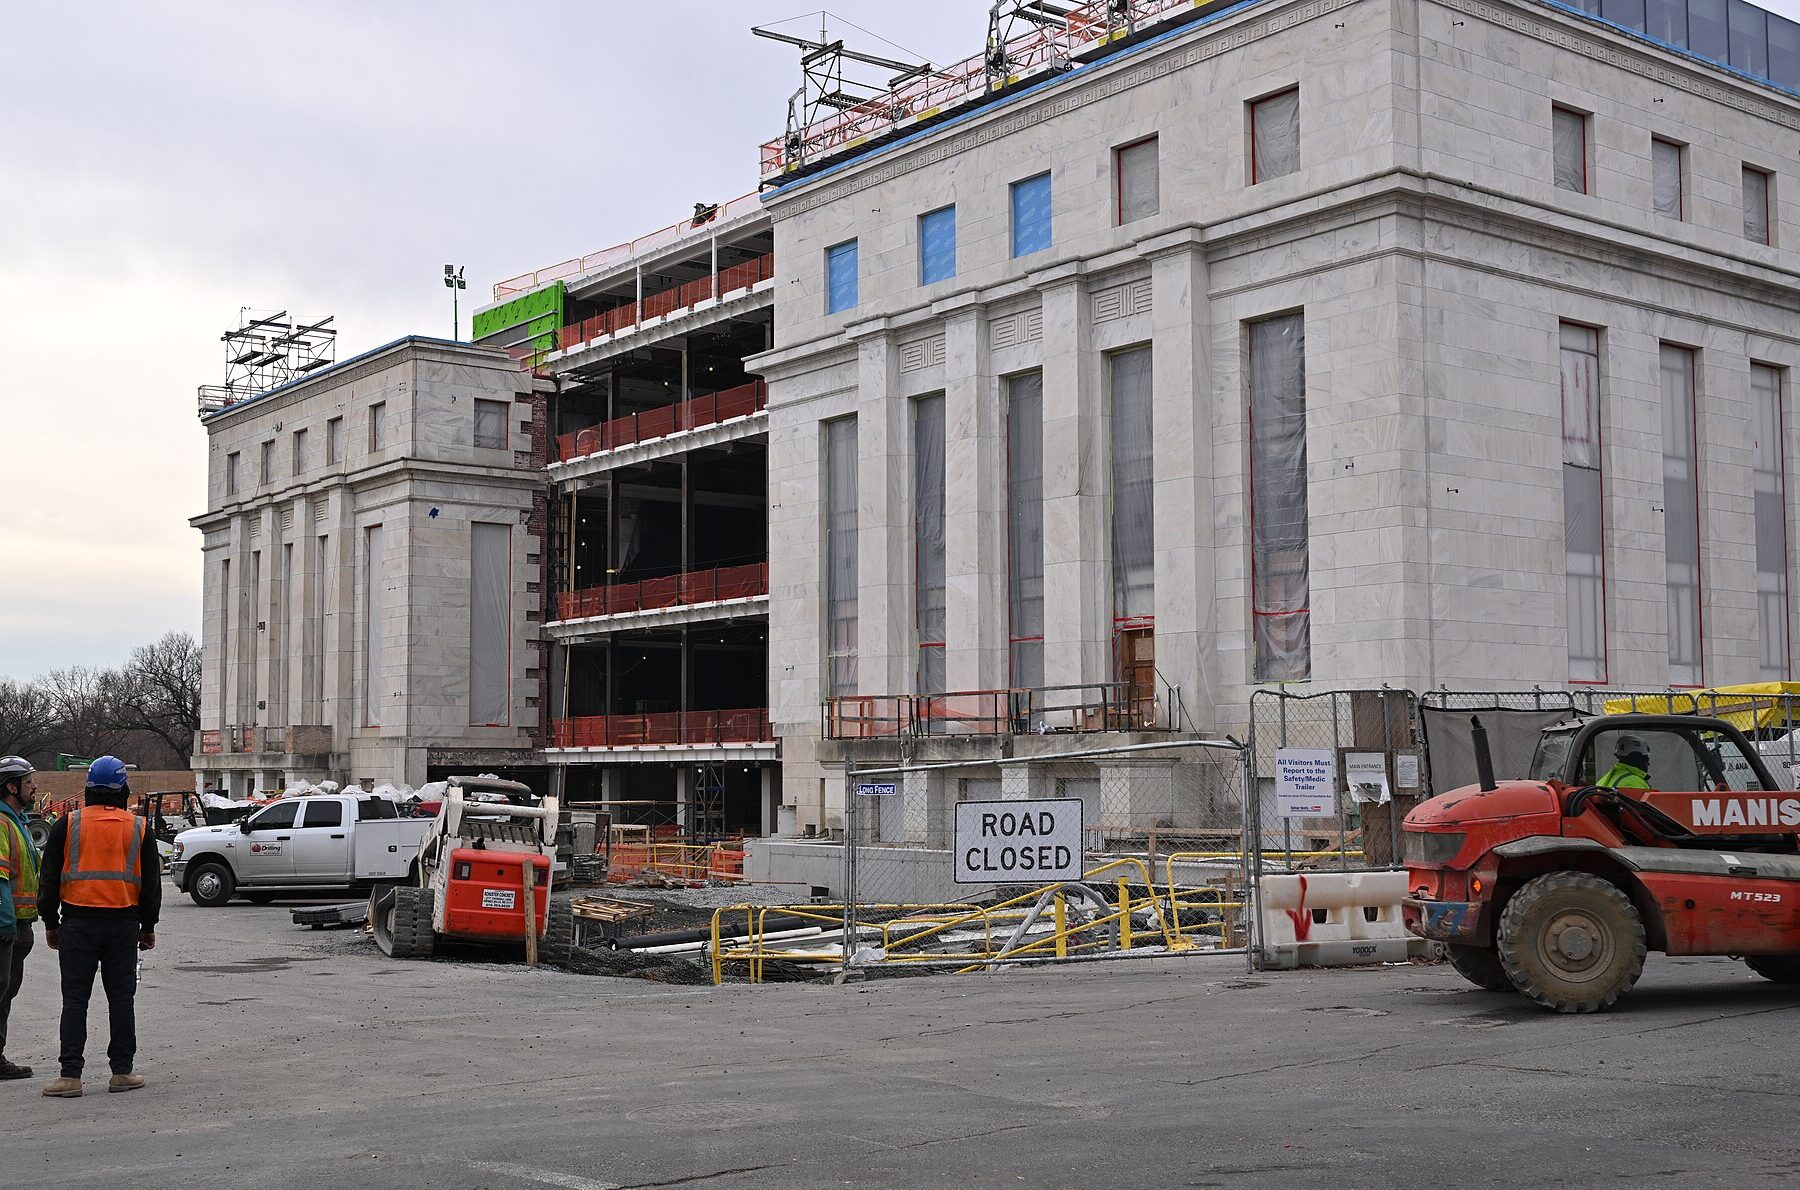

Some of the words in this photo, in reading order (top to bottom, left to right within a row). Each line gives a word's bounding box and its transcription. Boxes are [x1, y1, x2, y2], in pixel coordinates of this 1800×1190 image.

[860, 785, 874, 794] LONG
[874, 785, 894, 794] FENCE
[1692, 798, 1800, 826] MANIS
[982, 811, 1055, 837] ROAD
[966, 845, 1071, 871] CLOSED
[1730, 891, 1781, 902] MT523
[1352, 944, 1378, 954] YODOCK
